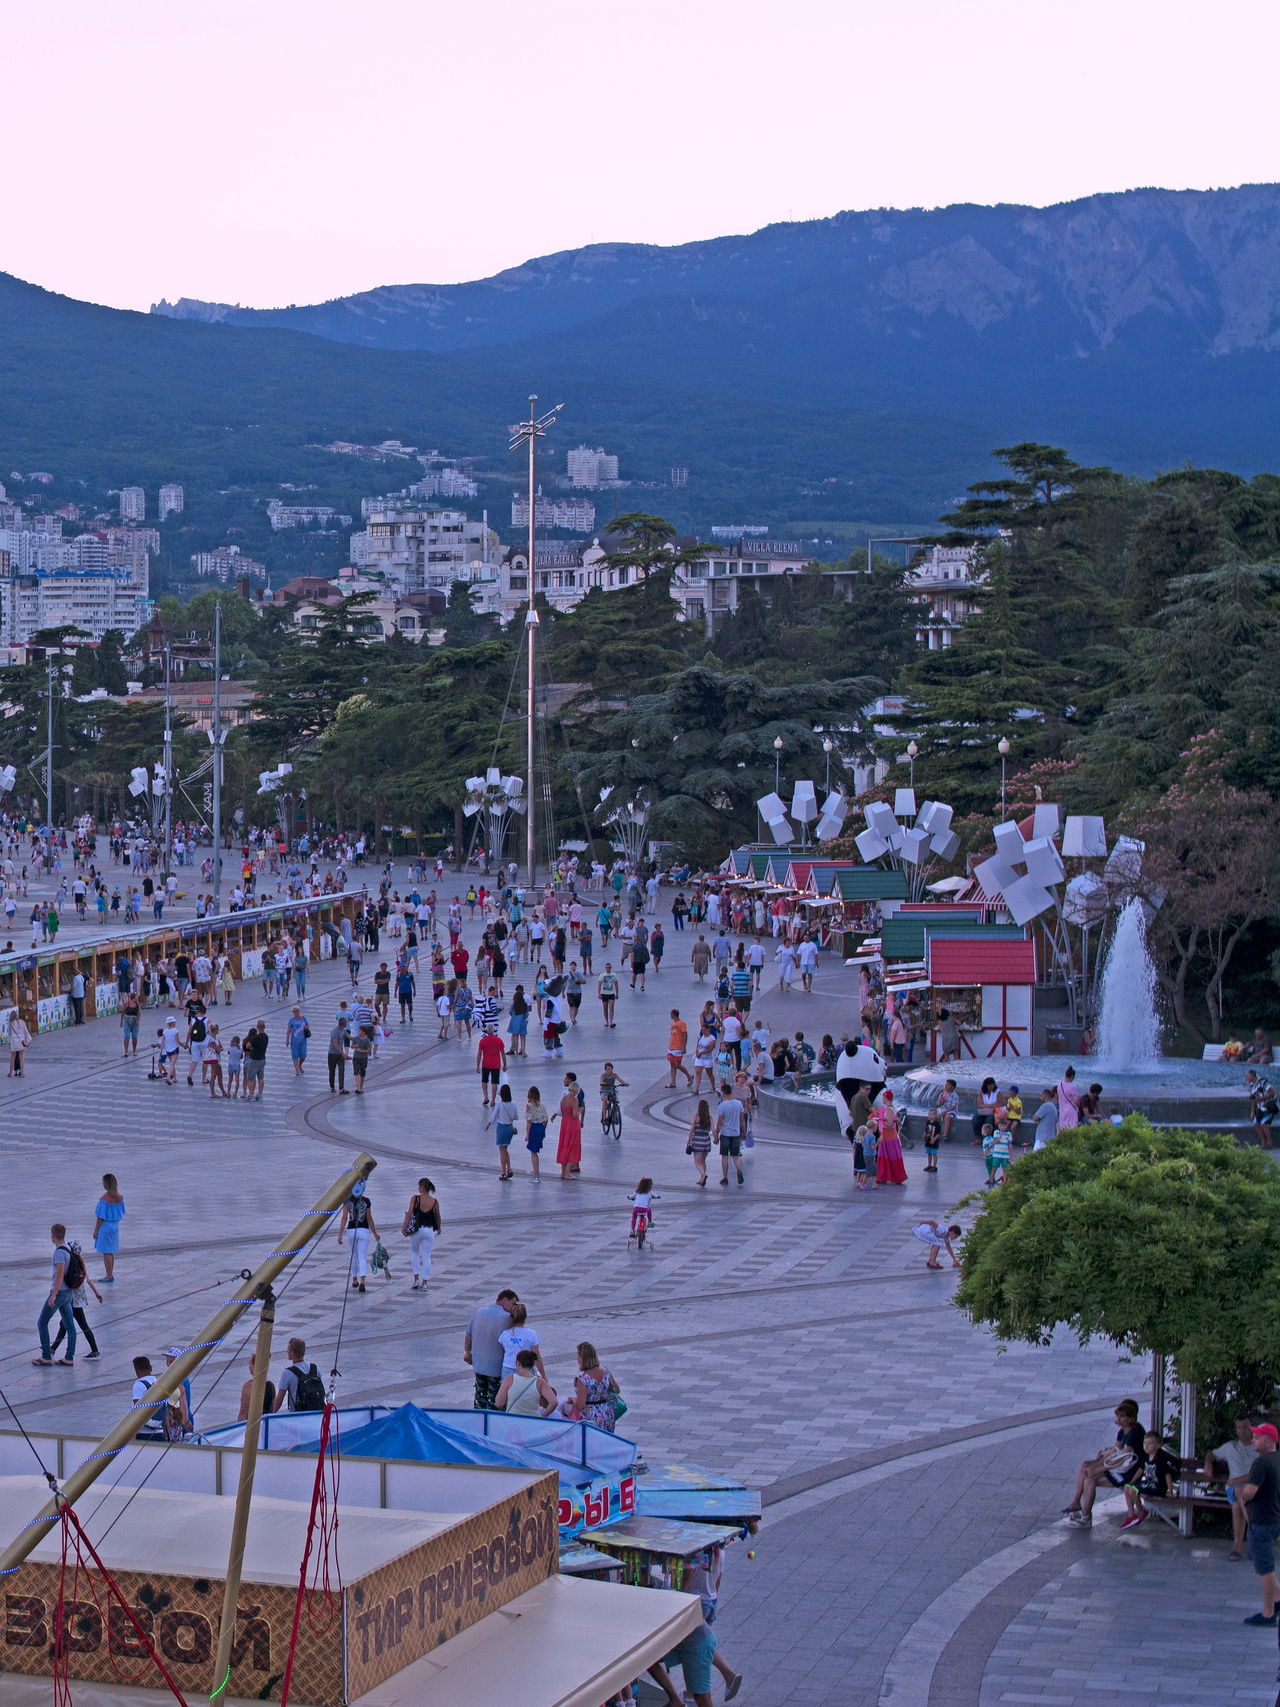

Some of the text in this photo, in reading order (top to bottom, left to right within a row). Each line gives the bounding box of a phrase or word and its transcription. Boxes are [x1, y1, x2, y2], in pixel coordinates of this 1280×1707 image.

[747, 542, 798, 553] VILLA ELENA
[355, 1494, 555, 1665] ТИР ПРИЗОВОЙ
